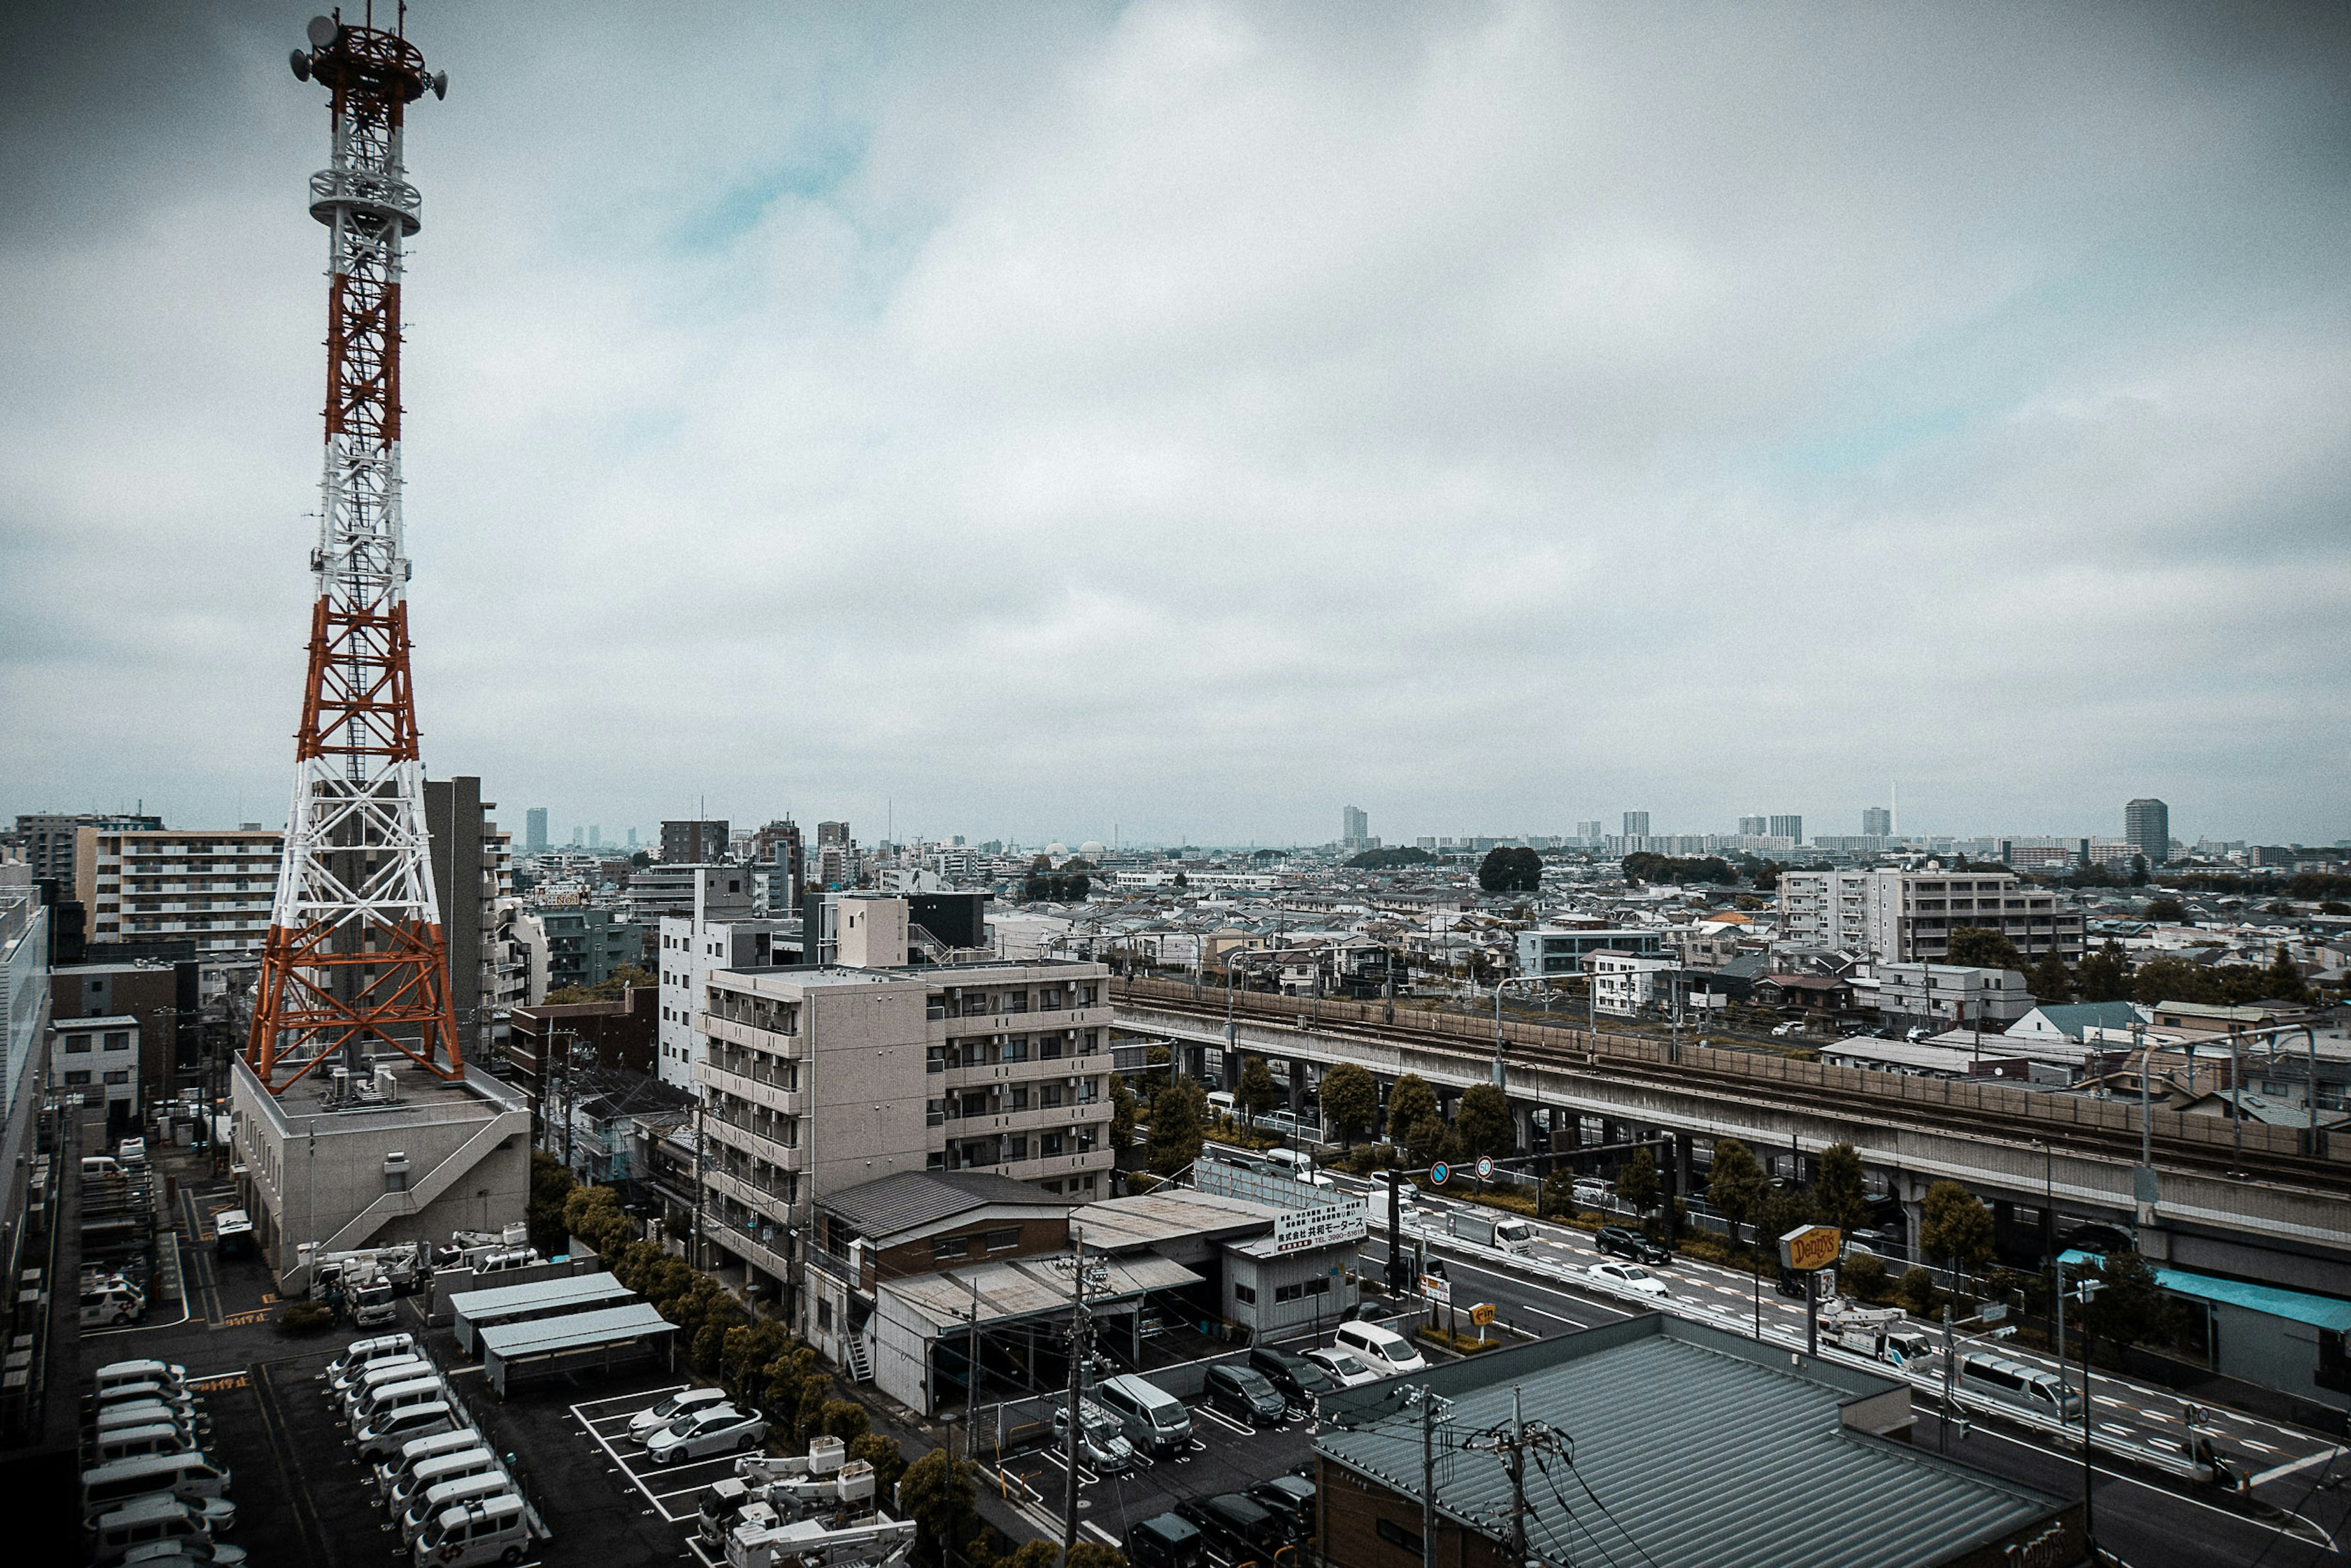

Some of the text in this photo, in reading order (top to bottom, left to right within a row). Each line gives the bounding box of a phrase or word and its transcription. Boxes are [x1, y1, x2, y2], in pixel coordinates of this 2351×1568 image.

[557, 895, 578, 904] No.1
[1480, 1162, 1490, 1172] 50
[1278, 1217, 1363, 1243] 株式会社 共和モータース
[1794, 1231, 1834, 1264] Denny's
[1121, 1472, 1135, 1481] 17
